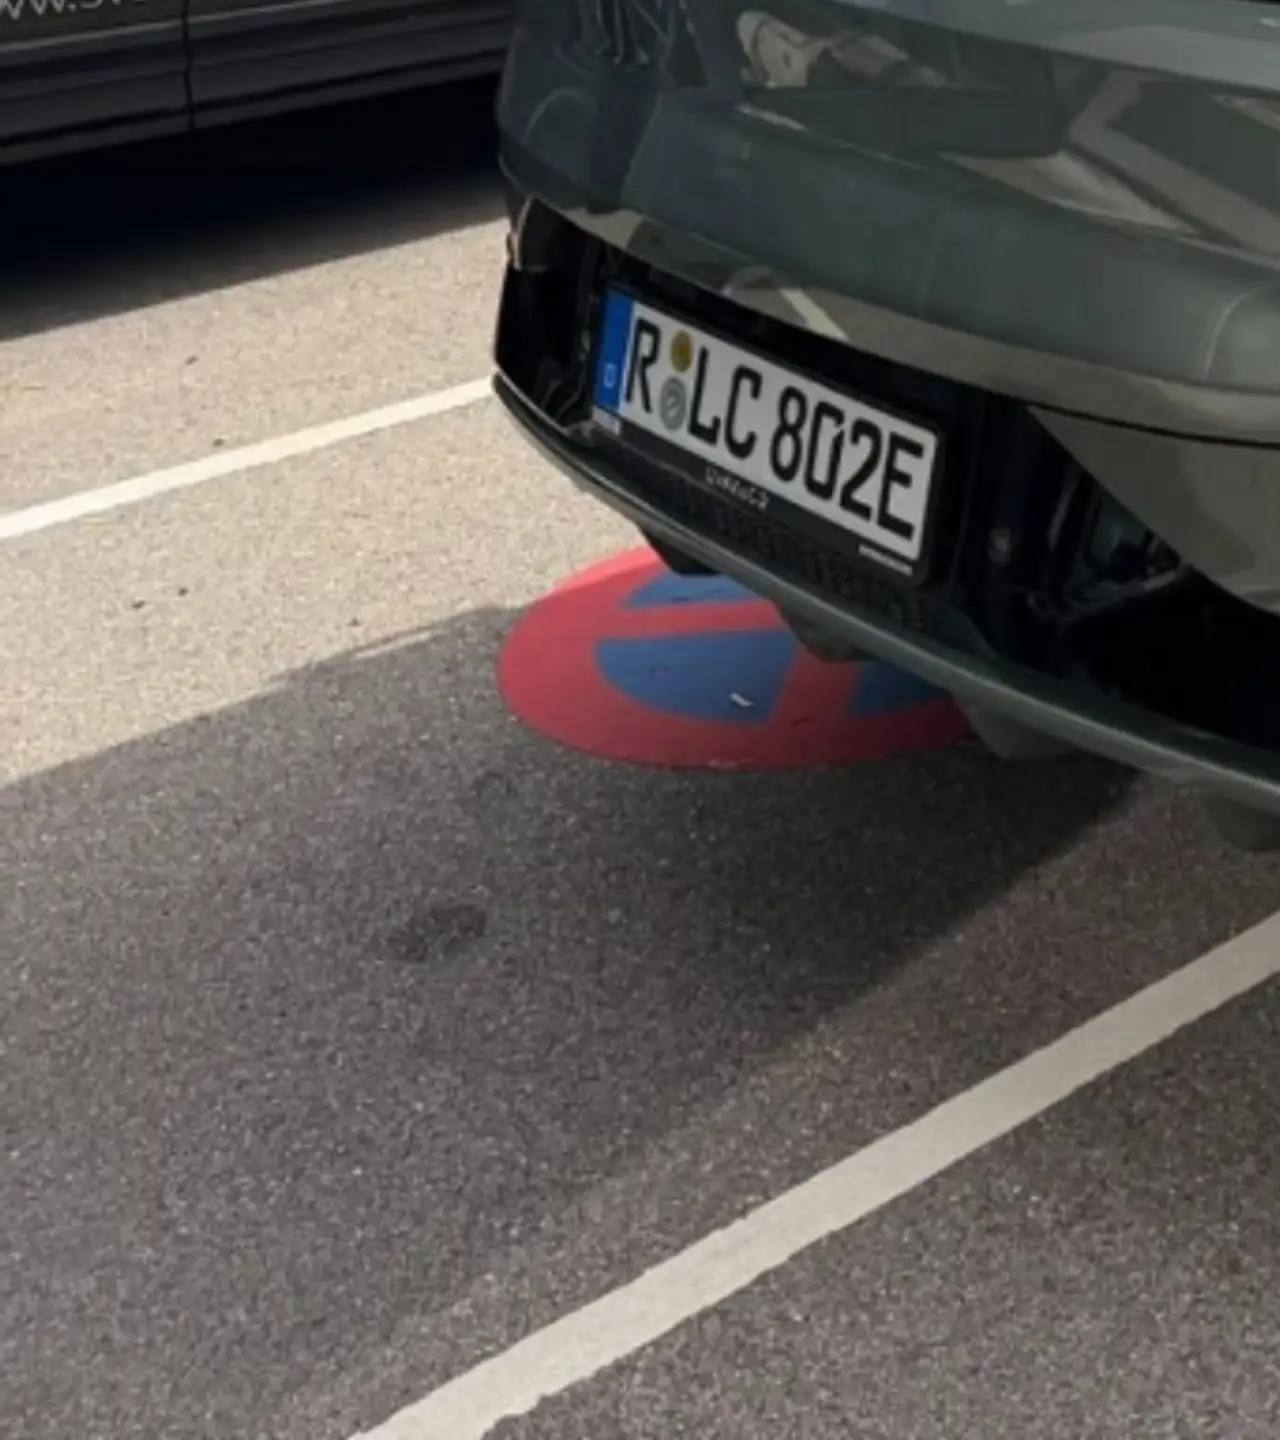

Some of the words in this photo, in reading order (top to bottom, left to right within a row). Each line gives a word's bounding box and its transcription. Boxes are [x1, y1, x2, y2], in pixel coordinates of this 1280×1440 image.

[625, 316, 661, 415] R
[688, 346, 763, 460] LC
[770, 385, 924, 541] 802E
